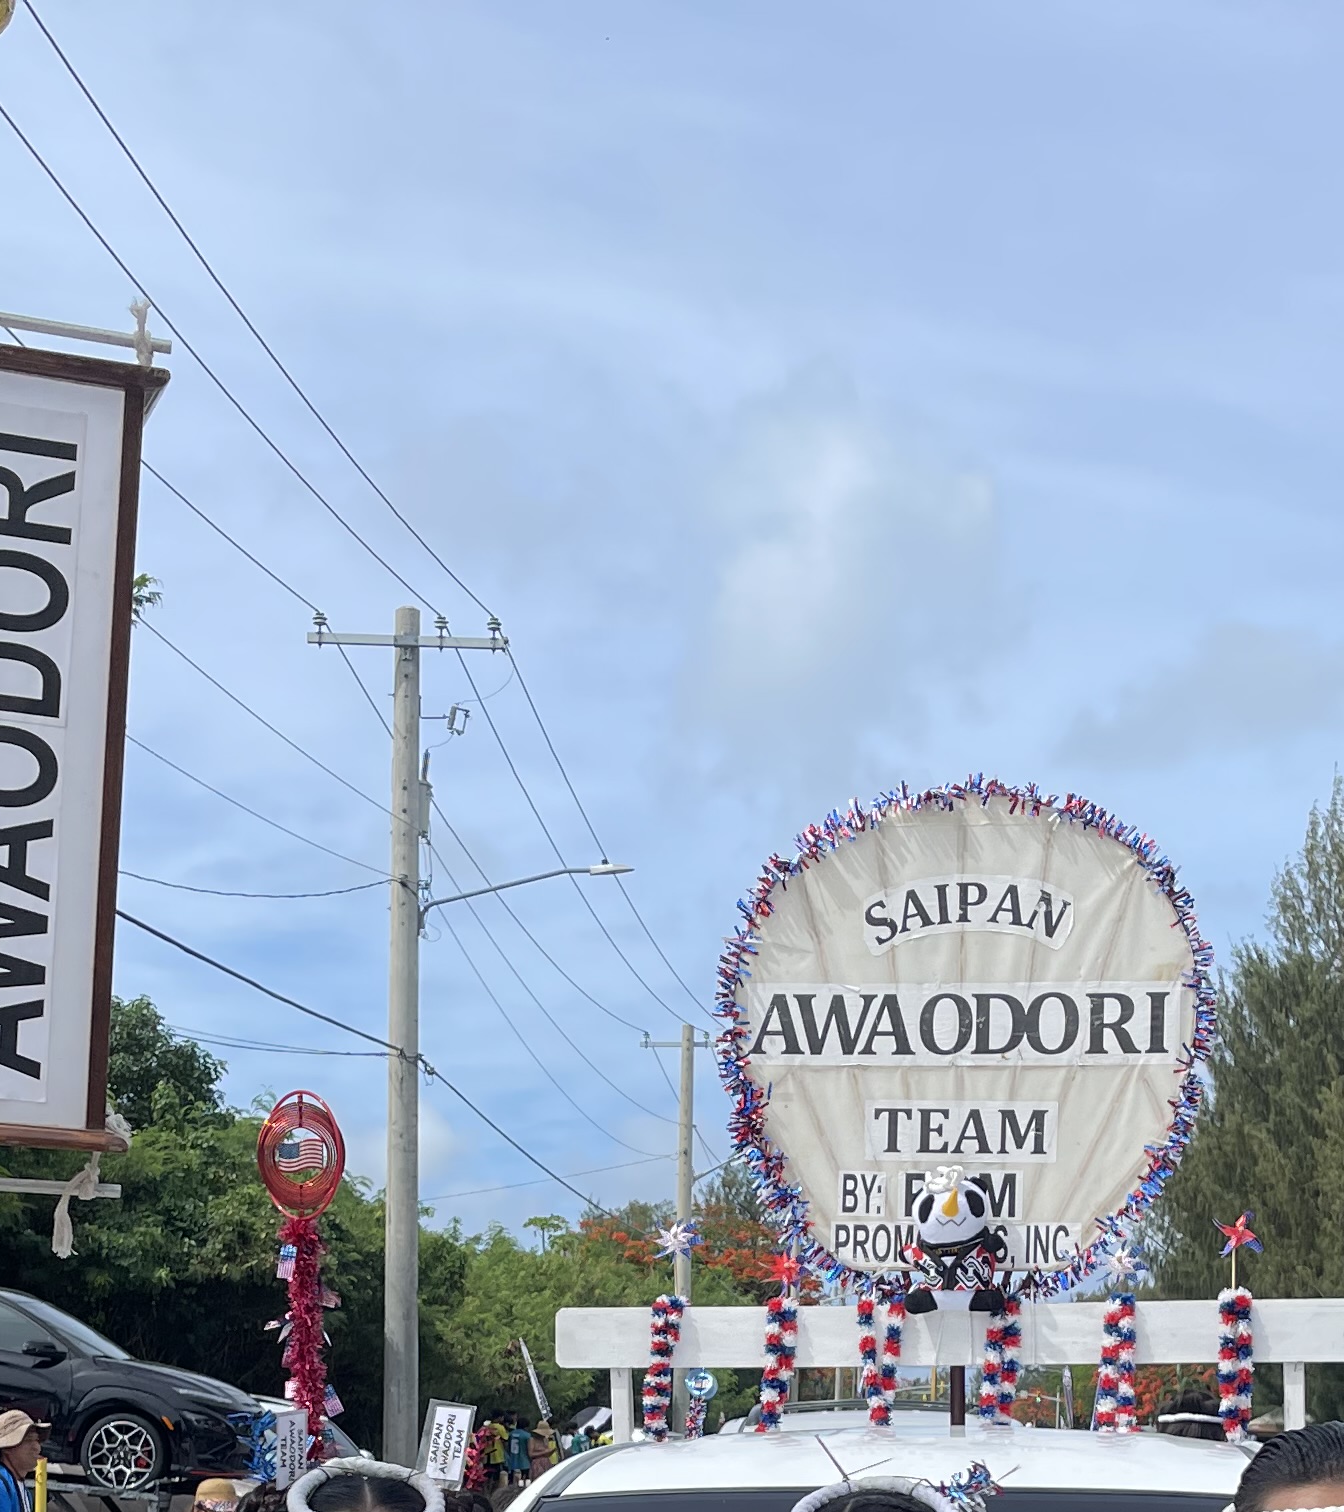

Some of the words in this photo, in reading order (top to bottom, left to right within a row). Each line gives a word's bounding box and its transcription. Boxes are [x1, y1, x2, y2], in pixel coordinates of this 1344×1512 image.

[865, 881, 1071, 946] SAIPAN
[750, 990, 1170, 1057] AWAODORI
[873, 1107, 1049, 1155] TEAM
[842, 1173, 882, 1214] BY:
[429, 1422, 444, 1464] SAIPAN
[440, 1413, 457, 1475] AWAODORI
[452, 1429, 465, 1460] TEAM
